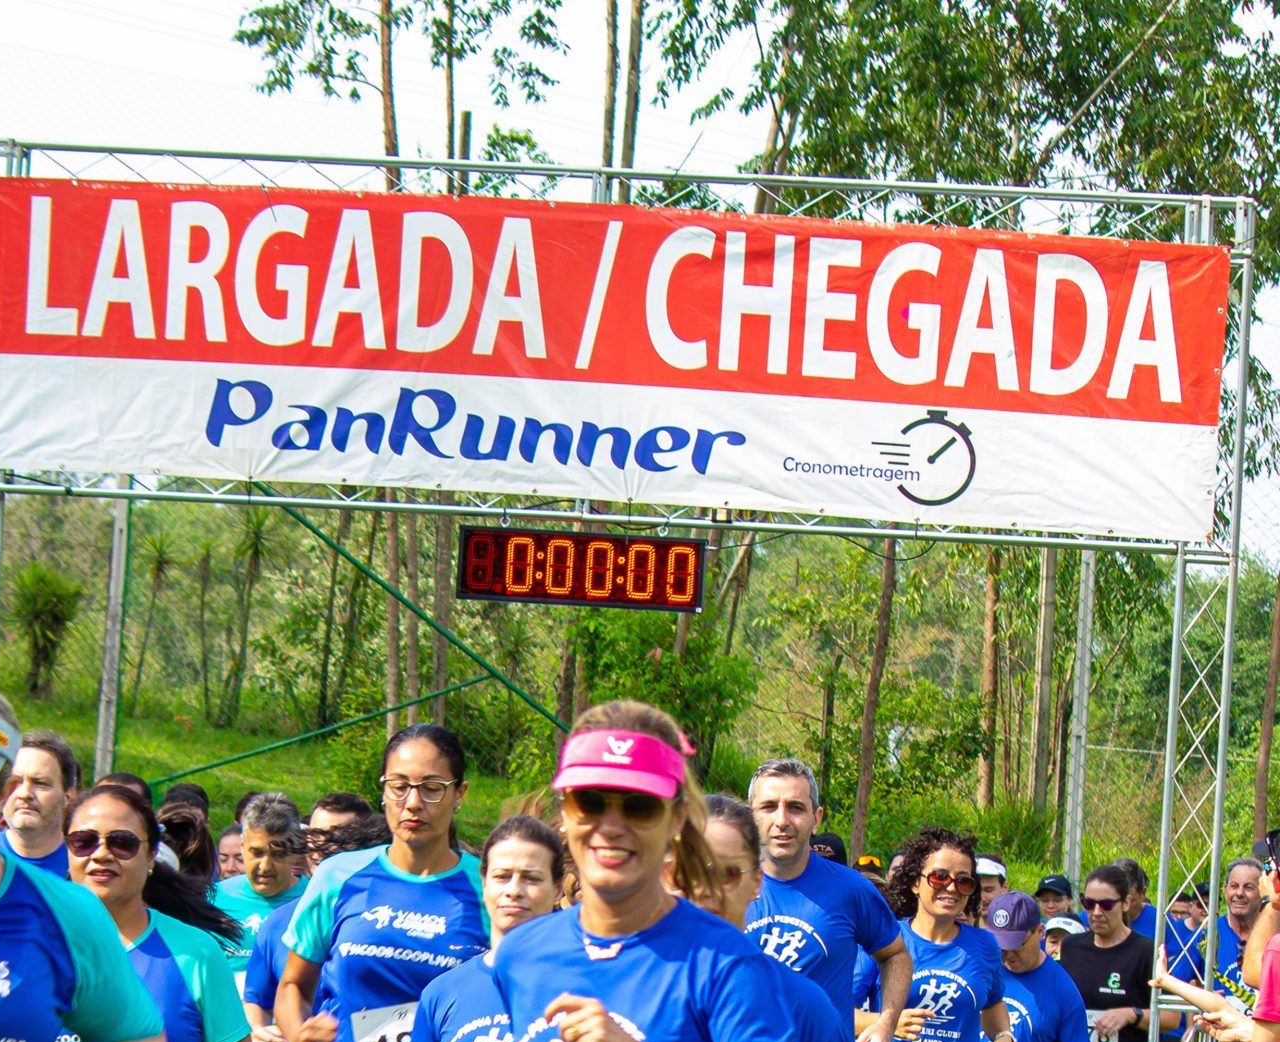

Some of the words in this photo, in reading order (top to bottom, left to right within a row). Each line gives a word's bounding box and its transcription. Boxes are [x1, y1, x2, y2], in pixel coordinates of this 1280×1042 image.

[25, 195, 547, 359] LARGADA
[574, 220, 623, 369] /
[645, 225, 1182, 403] CHEGADA
[206, 377, 746, 475] PanRunner
[782, 456, 921, 482] Cronometragem
[746, 915, 773, 933] PROVA
